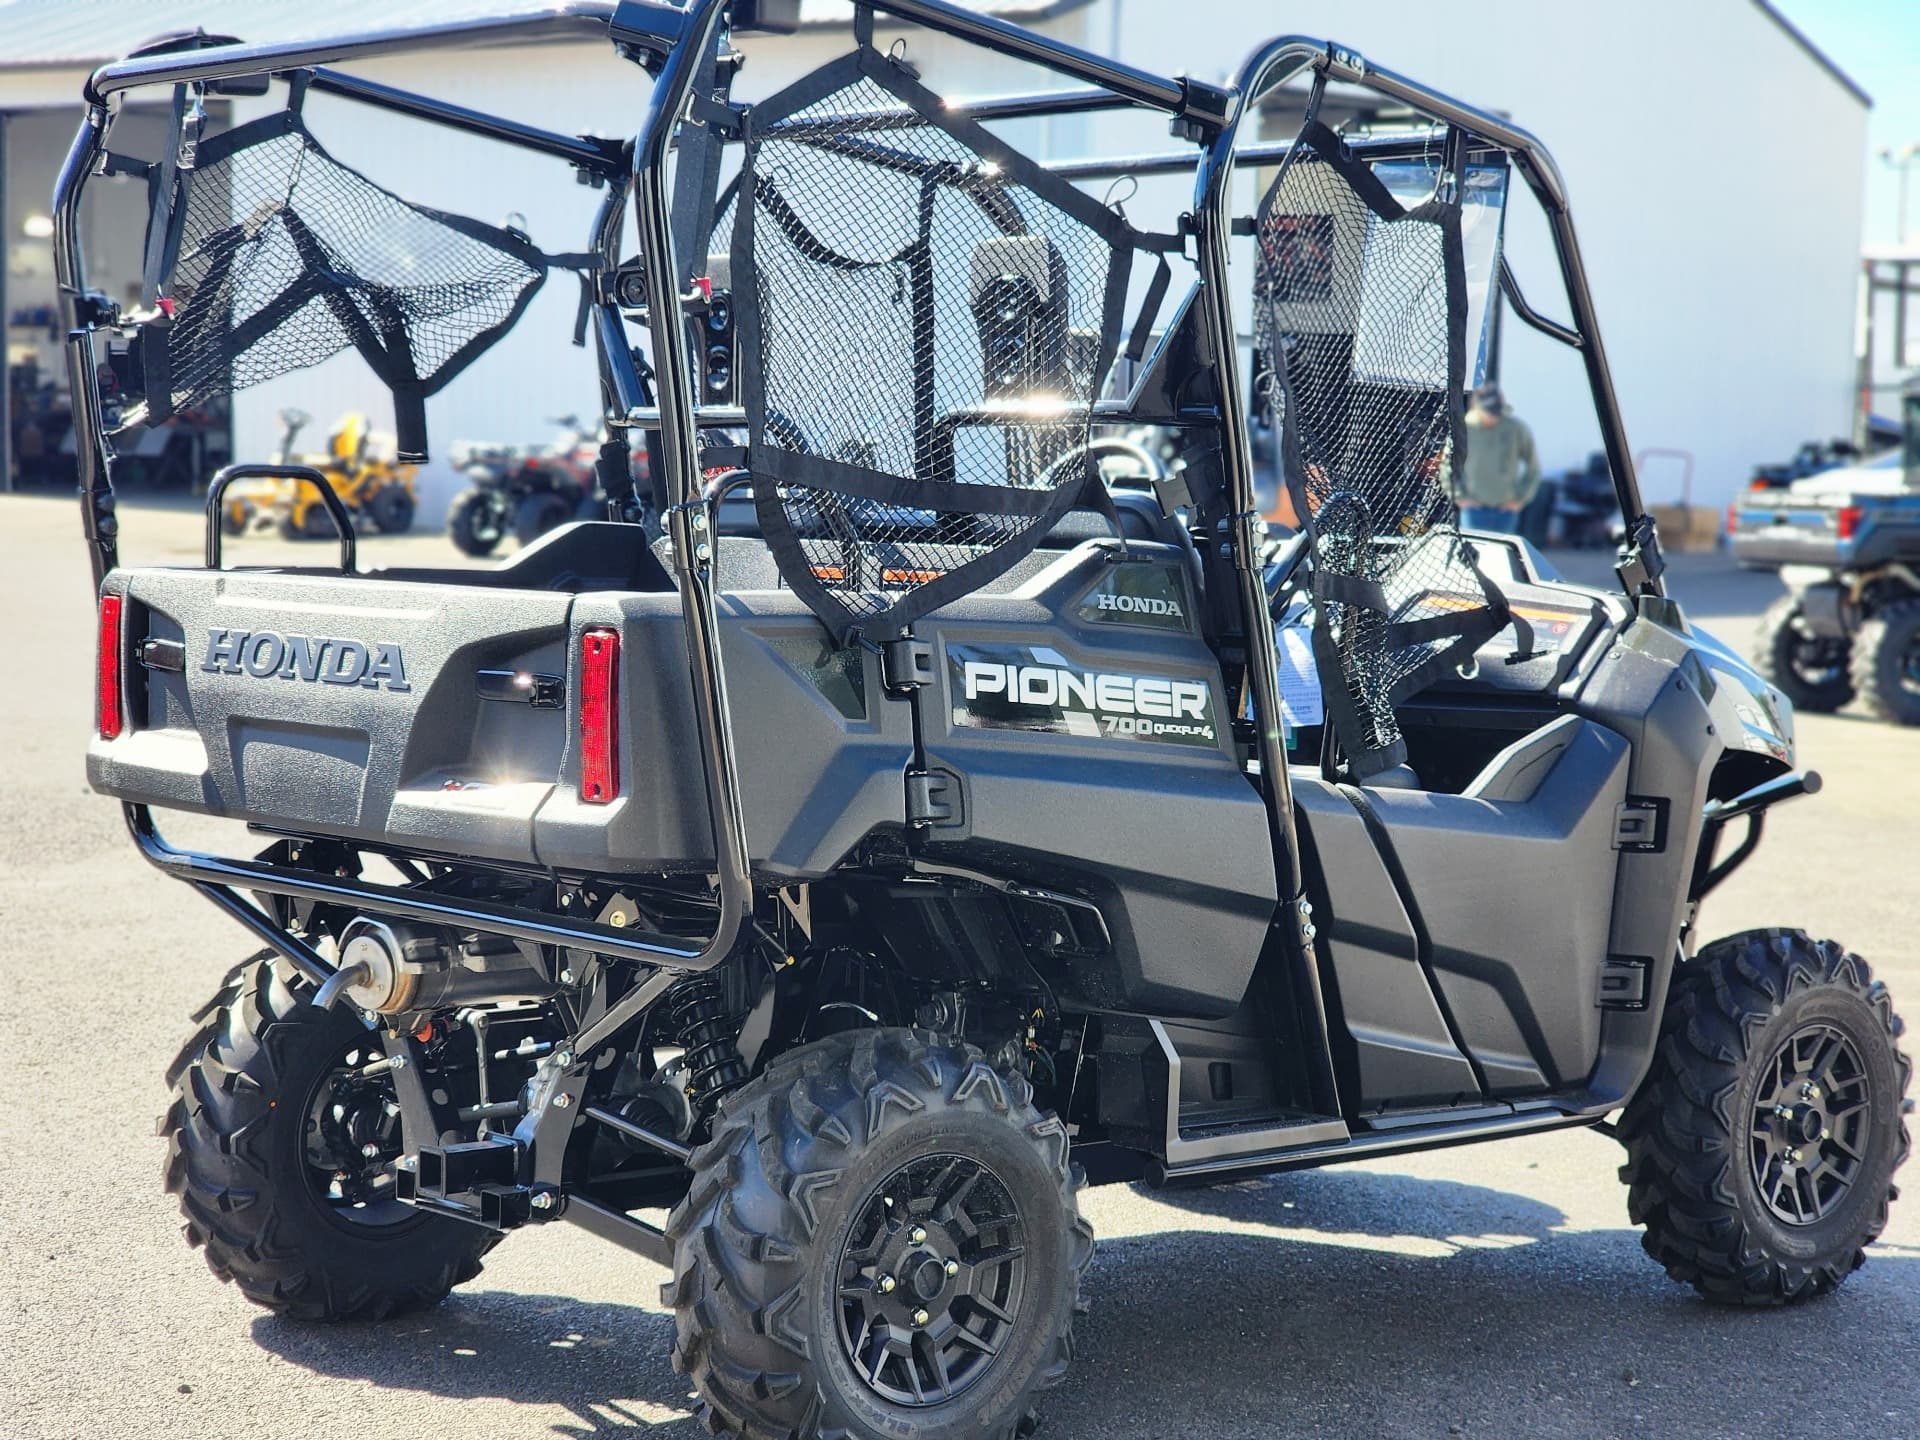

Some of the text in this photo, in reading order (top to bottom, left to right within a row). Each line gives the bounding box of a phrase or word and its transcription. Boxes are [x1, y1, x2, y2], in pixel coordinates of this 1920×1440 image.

[1097, 594, 1183, 617] HONDA
[201, 627, 411, 692] HONDA
[964, 661, 1205, 720] PIONEER
[1101, 715, 1153, 735] 700
